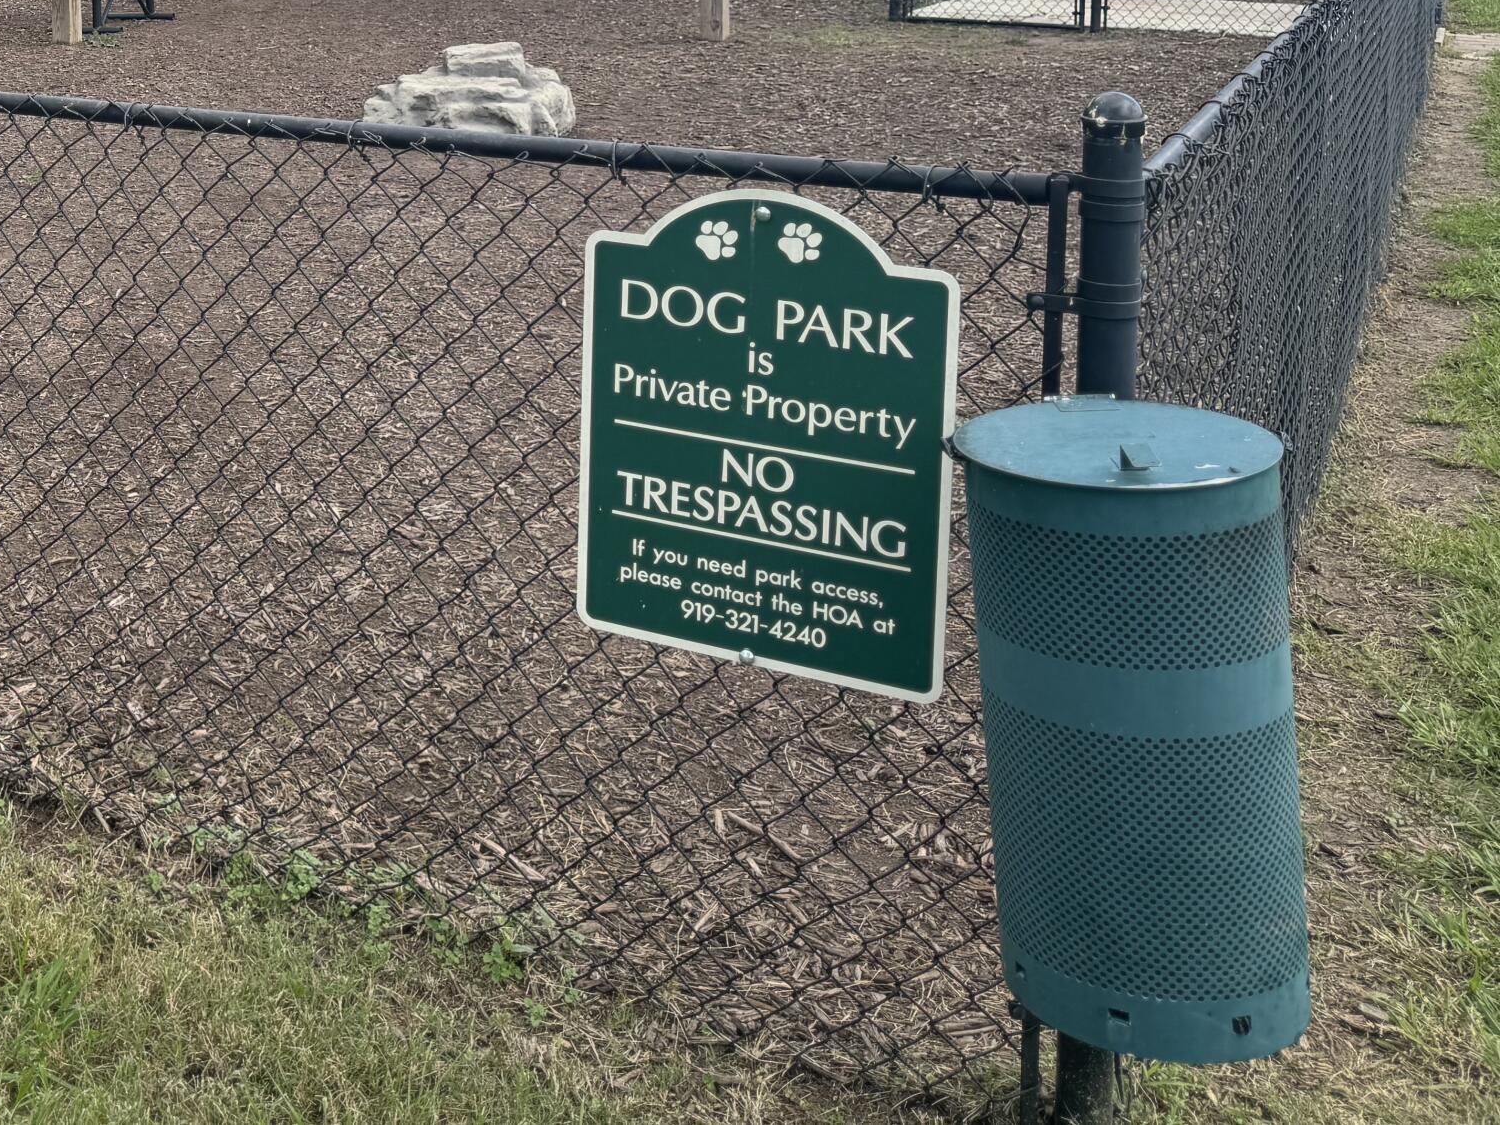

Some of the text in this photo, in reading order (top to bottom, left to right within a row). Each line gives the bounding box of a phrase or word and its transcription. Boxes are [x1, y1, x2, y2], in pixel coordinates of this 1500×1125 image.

[621, 279, 915, 359] DOG PARK
[748, 342, 774, 376] is
[614, 363, 917, 450] Private Property
[721, 448, 795, 493] NO
[617, 470, 907, 558] TRESPASSING
[620, 563, 896, 635] please contact the HOA at
[631, 538, 884, 608] If you need park access,
[681, 600, 827, 649] 919-321-4240
